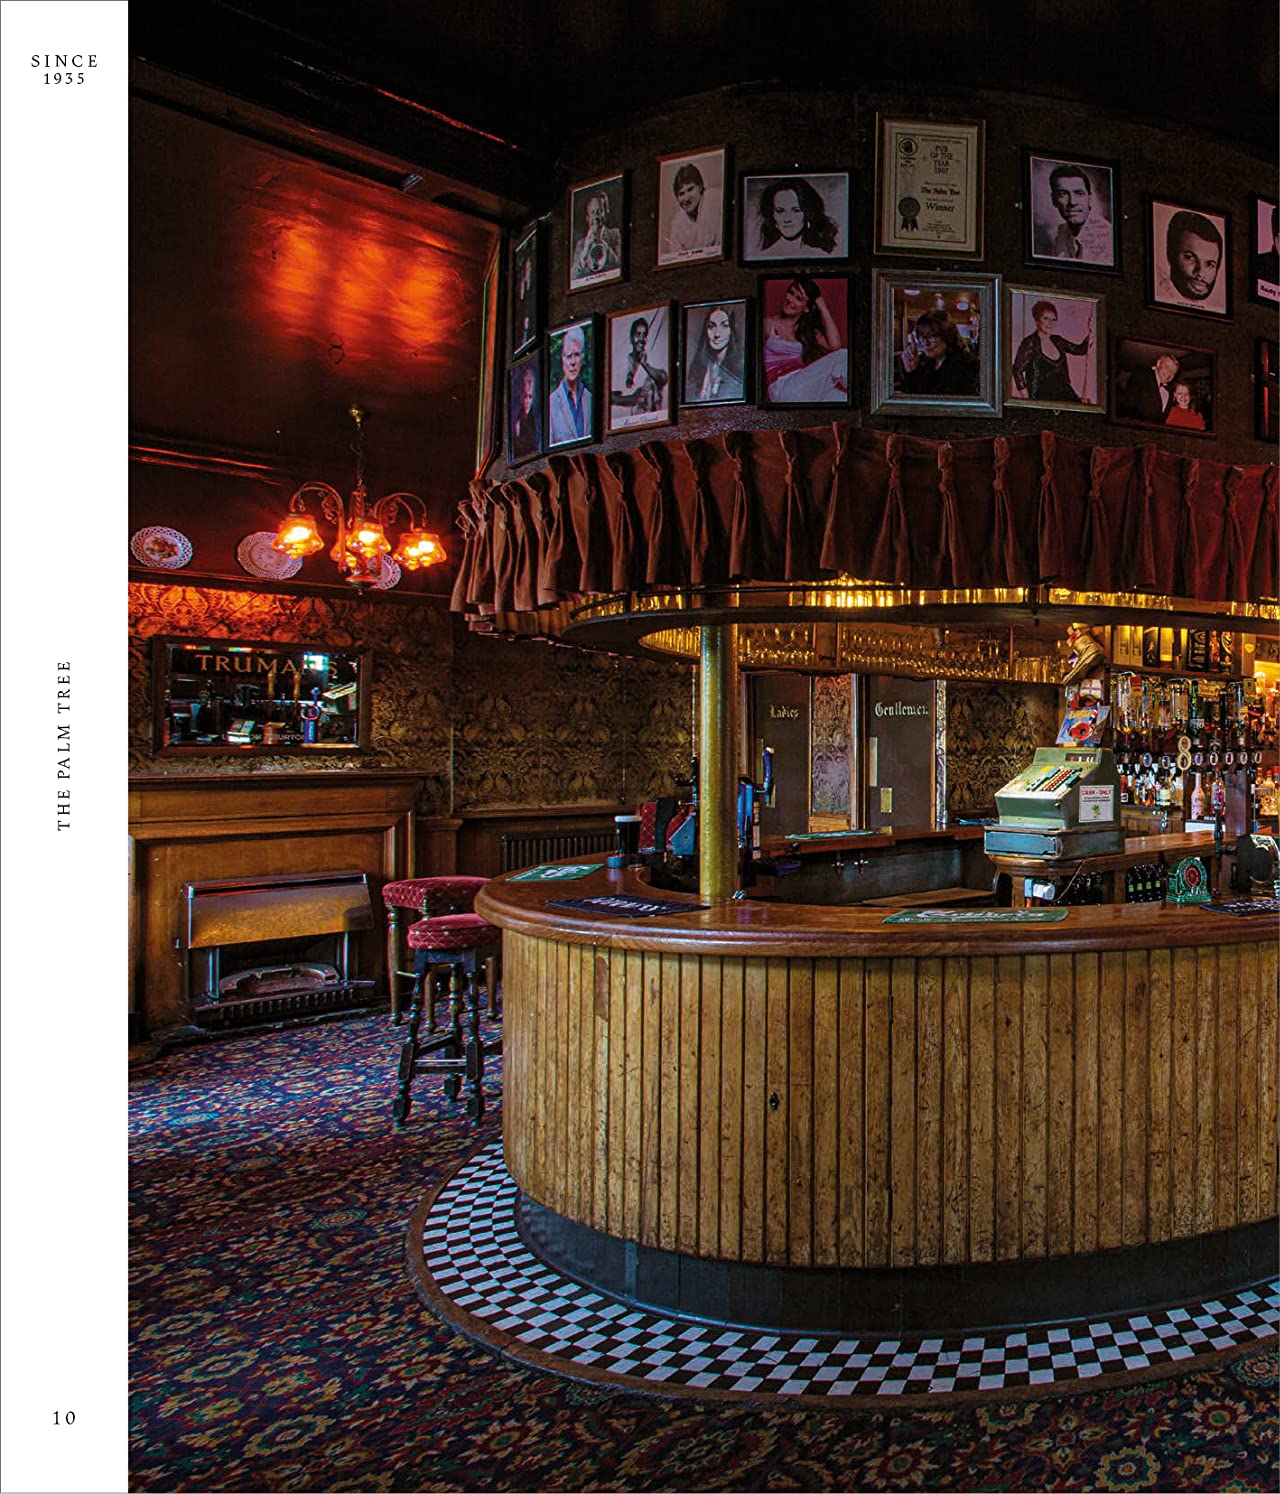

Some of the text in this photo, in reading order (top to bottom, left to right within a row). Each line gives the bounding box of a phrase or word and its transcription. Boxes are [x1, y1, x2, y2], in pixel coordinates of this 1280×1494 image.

[926, 202, 955, 212] Winner
[195, 653, 338, 677] TRUMAS
[769, 704, 800, 719] Ladies
